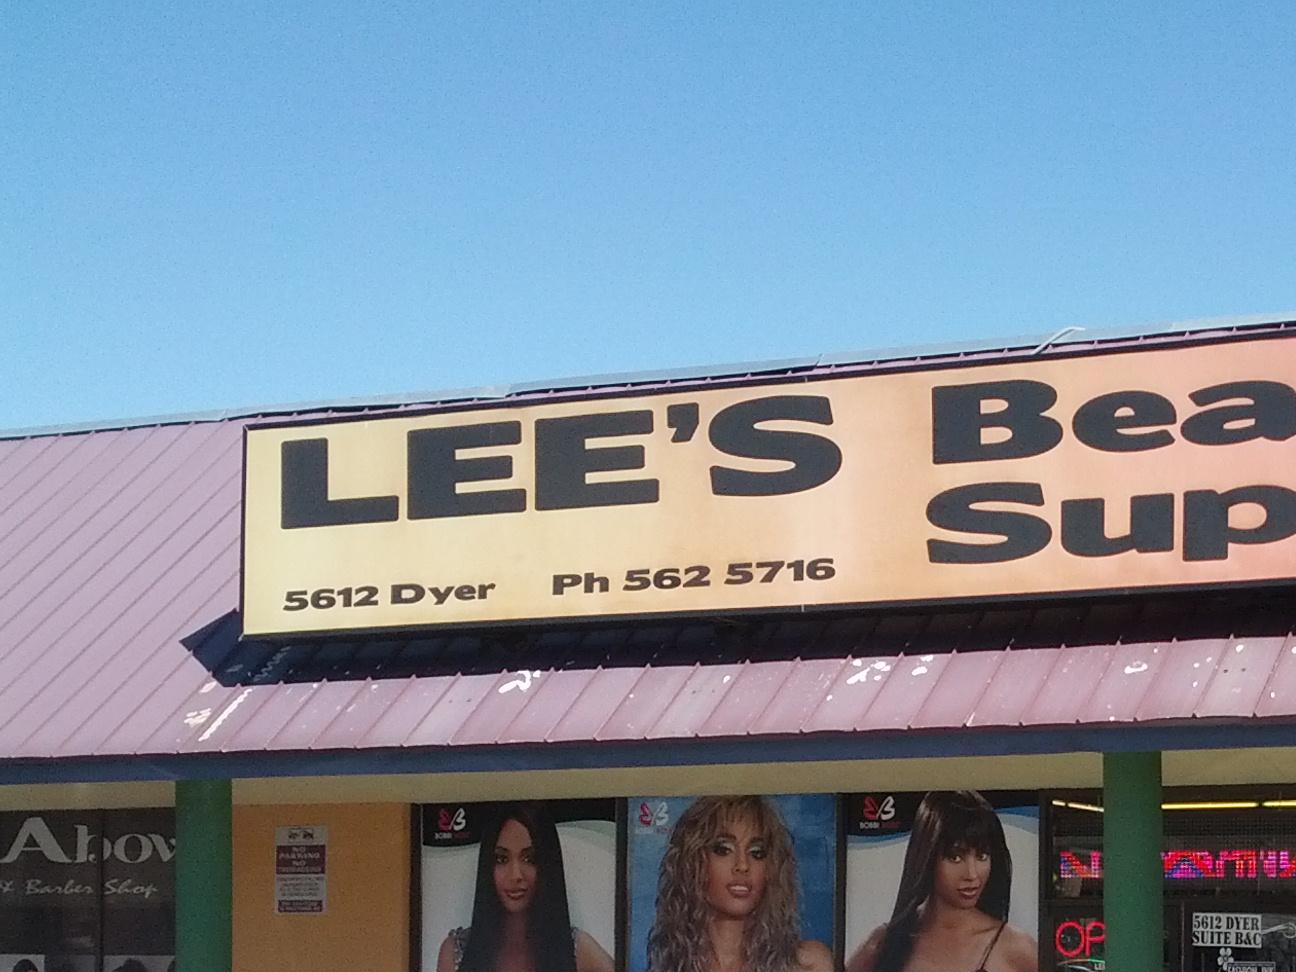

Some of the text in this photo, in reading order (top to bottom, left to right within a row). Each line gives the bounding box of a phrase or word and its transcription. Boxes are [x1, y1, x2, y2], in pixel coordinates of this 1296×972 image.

[281, 395, 842, 530] LEE'S
[551, 557, 836, 597] Ph 562 5716
[282, 579, 496, 612] 5612 Dyer
[25, 878, 95, 895] Barber
[104, 878, 158, 899] Shop
[1193, 914, 1260, 931] 5612 DYER
[1192, 930, 1262, 946] SUITE B&C
